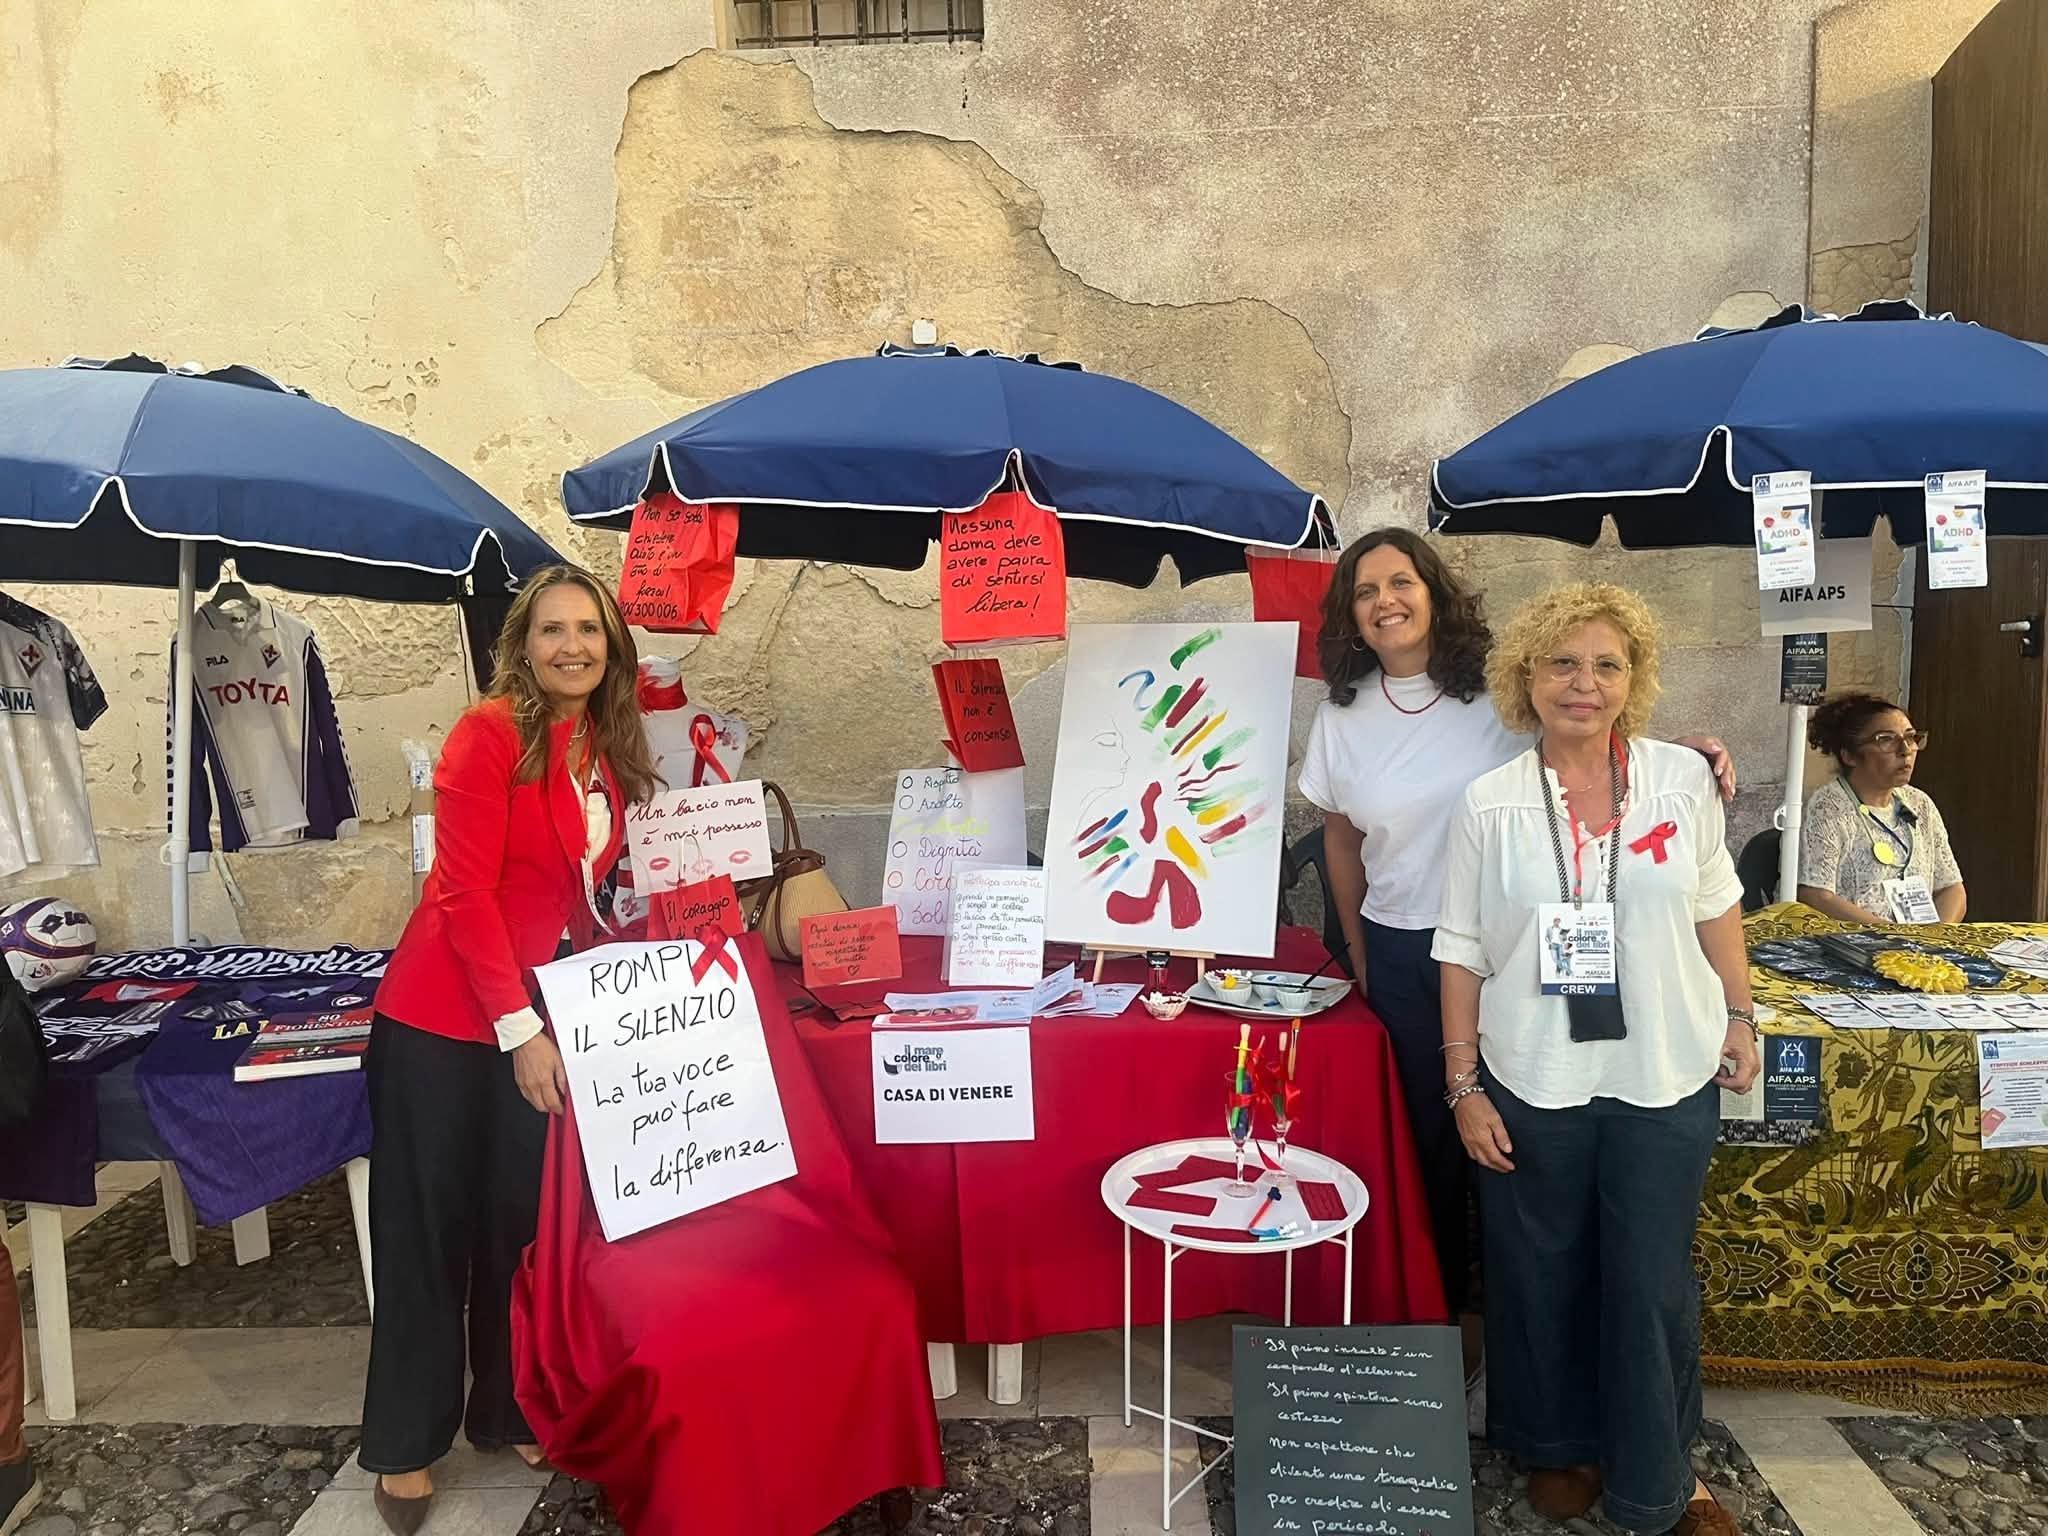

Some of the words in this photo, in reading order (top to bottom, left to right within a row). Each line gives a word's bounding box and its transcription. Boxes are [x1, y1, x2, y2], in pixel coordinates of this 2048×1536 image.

[950, 518, 1015, 535] Nessuna
[1770, 528, 1800, 539] ADHD
[1943, 527, 1973, 537] ADHD
[1004, 534, 1042, 550] deve
[947, 556, 987, 570] avere
[997, 555, 1052, 576] paura
[952, 574, 974, 588] di
[986, 569, 1046, 587] sentirsi
[1779, 587, 1814, 603] AIFA
[1817, 585, 1846, 600] APS
[205, 655, 229, 667] FILA
[208, 678, 290, 707] TOYTA
[964, 728, 1011, 743] consenso
[630, 802, 666, 822] Un
[672, 798, 719, 817] bacio
[725, 796, 756, 806] non
[703, 820, 763, 841] possesso
[918, 837, 981, 875] Dignità
[666, 900, 676, 923] Il
[590, 943, 693, 998] ROMPI
[1560, 985, 1597, 994] CREW
[273, 1019, 372, 1032] FIORENTINA
[575, 1024, 598, 1052] IL
[614, 987, 736, 1047] SILENZIO
[212, 1021, 251, 1041] LA
[894, 1053, 930, 1063] colore
[914, 1046, 944, 1056] mare
[904, 1061, 922, 1072] dei
[925, 1060, 947, 1072] libri
[593, 1080, 625, 1106] La
[631, 1062, 667, 1096] tua
[673, 1054, 735, 1085] voce
[1767, 1075, 1793, 1083] AIFA
[1794, 1075, 1816, 1084] APS
[884, 1088, 926, 1101] CASA
[929, 1088, 945, 1101] DI
[949, 1085, 1014, 1101] VENERE
[682, 1089, 735, 1131] fare
[614, 1165, 641, 1200] la
[1265, 1338, 1288, 1352] Il
[1291, 1343, 1330, 1360] primo
[1404, 1351, 1433, 1359] un
[1267, 1381, 1289, 1397] Il
[1293, 1387, 1330, 1403] primo
[1304, 1440, 1378, 1455] aspettare
[1385, 1445, 1415, 1457] che
[1329, 1472, 1365, 1481] una
[1374, 1467, 1458, 1493] tragedia
[1305, 1496, 1363, 1511] credere
[1371, 1496, 1391, 1513] di
[1397, 1506, 1451, 1519] essere
[1273, 1518, 1300, 1529] in
